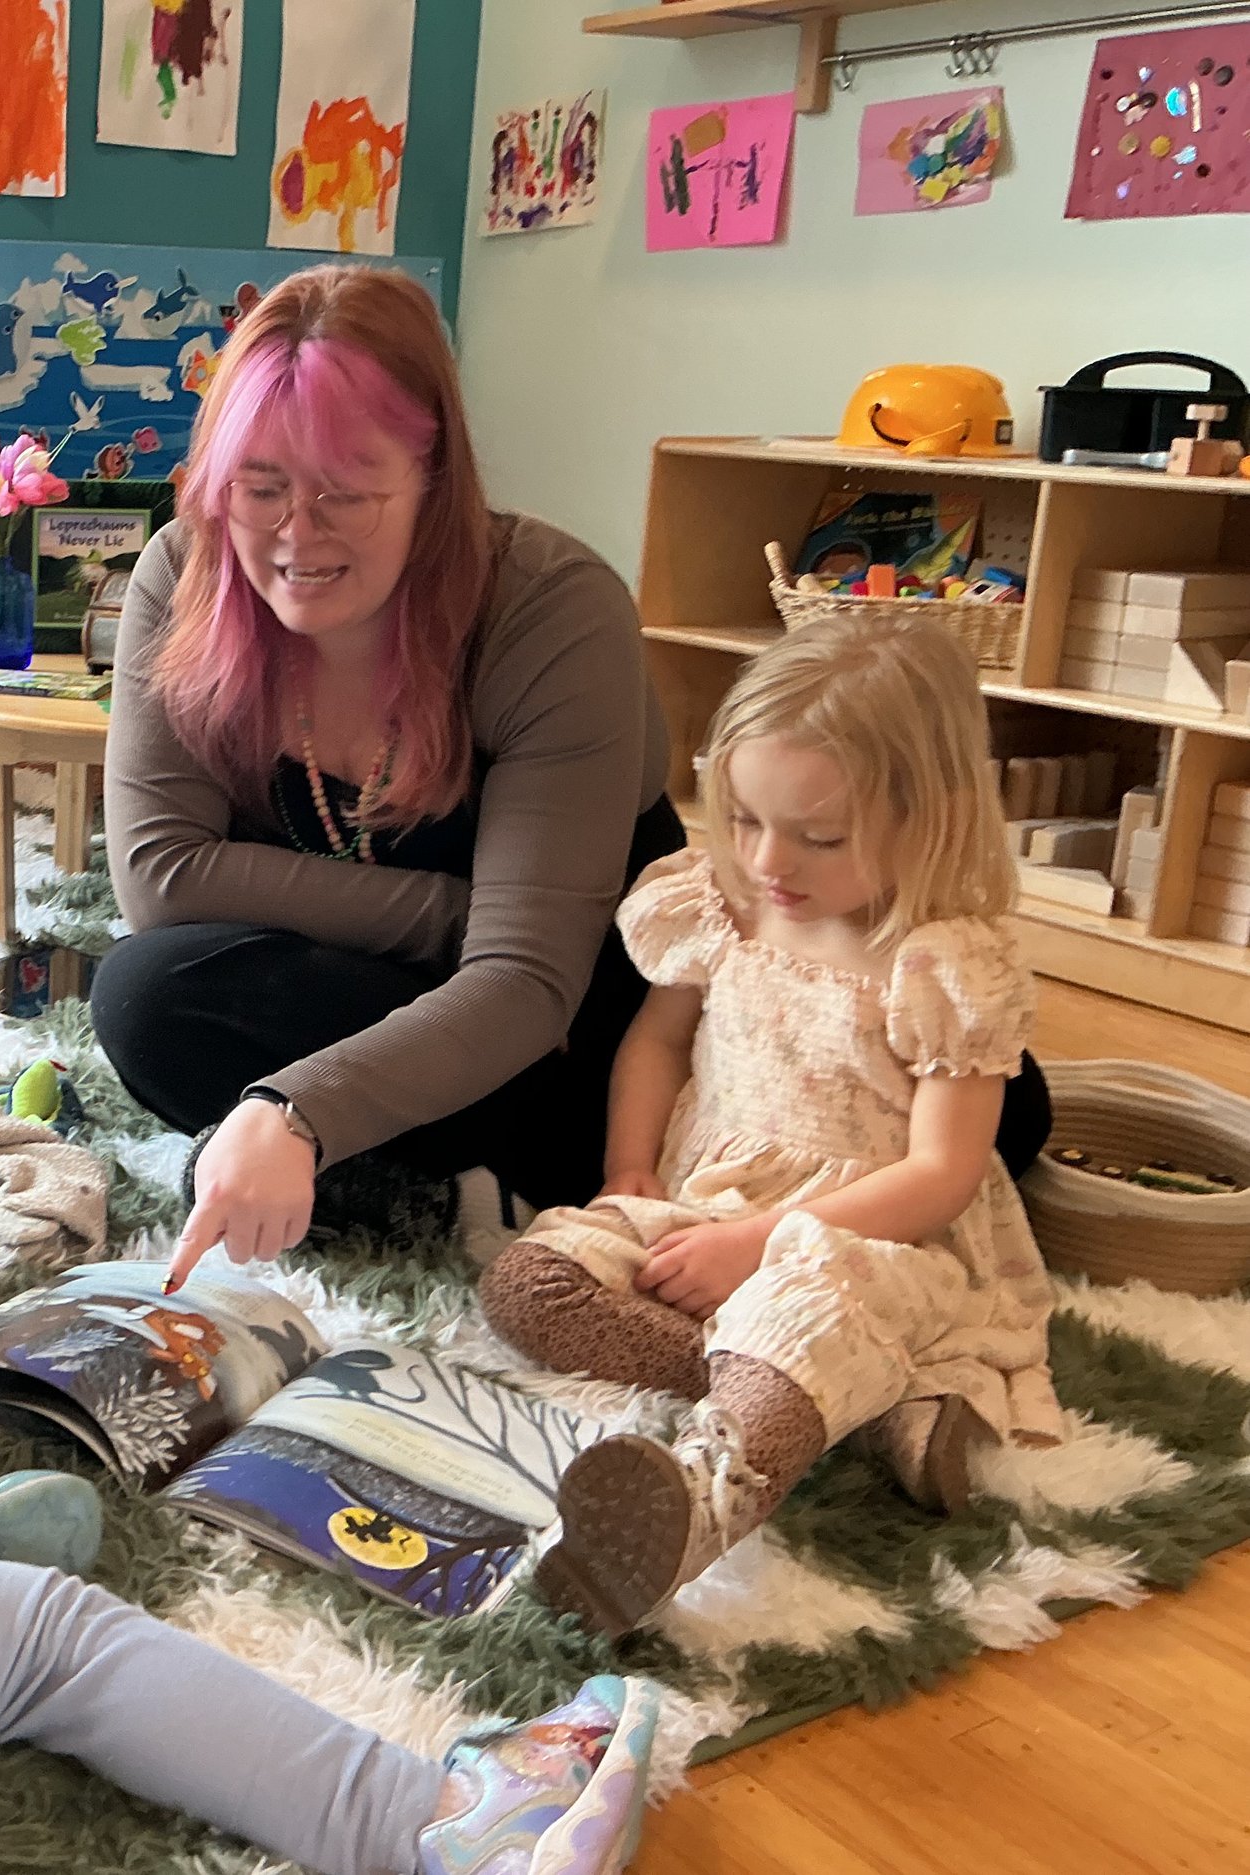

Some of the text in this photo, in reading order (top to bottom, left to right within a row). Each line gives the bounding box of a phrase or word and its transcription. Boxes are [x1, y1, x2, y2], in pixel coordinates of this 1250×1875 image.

[50, 517, 137, 533] Leprechauns
[58, 534, 125, 547] Never Lie
